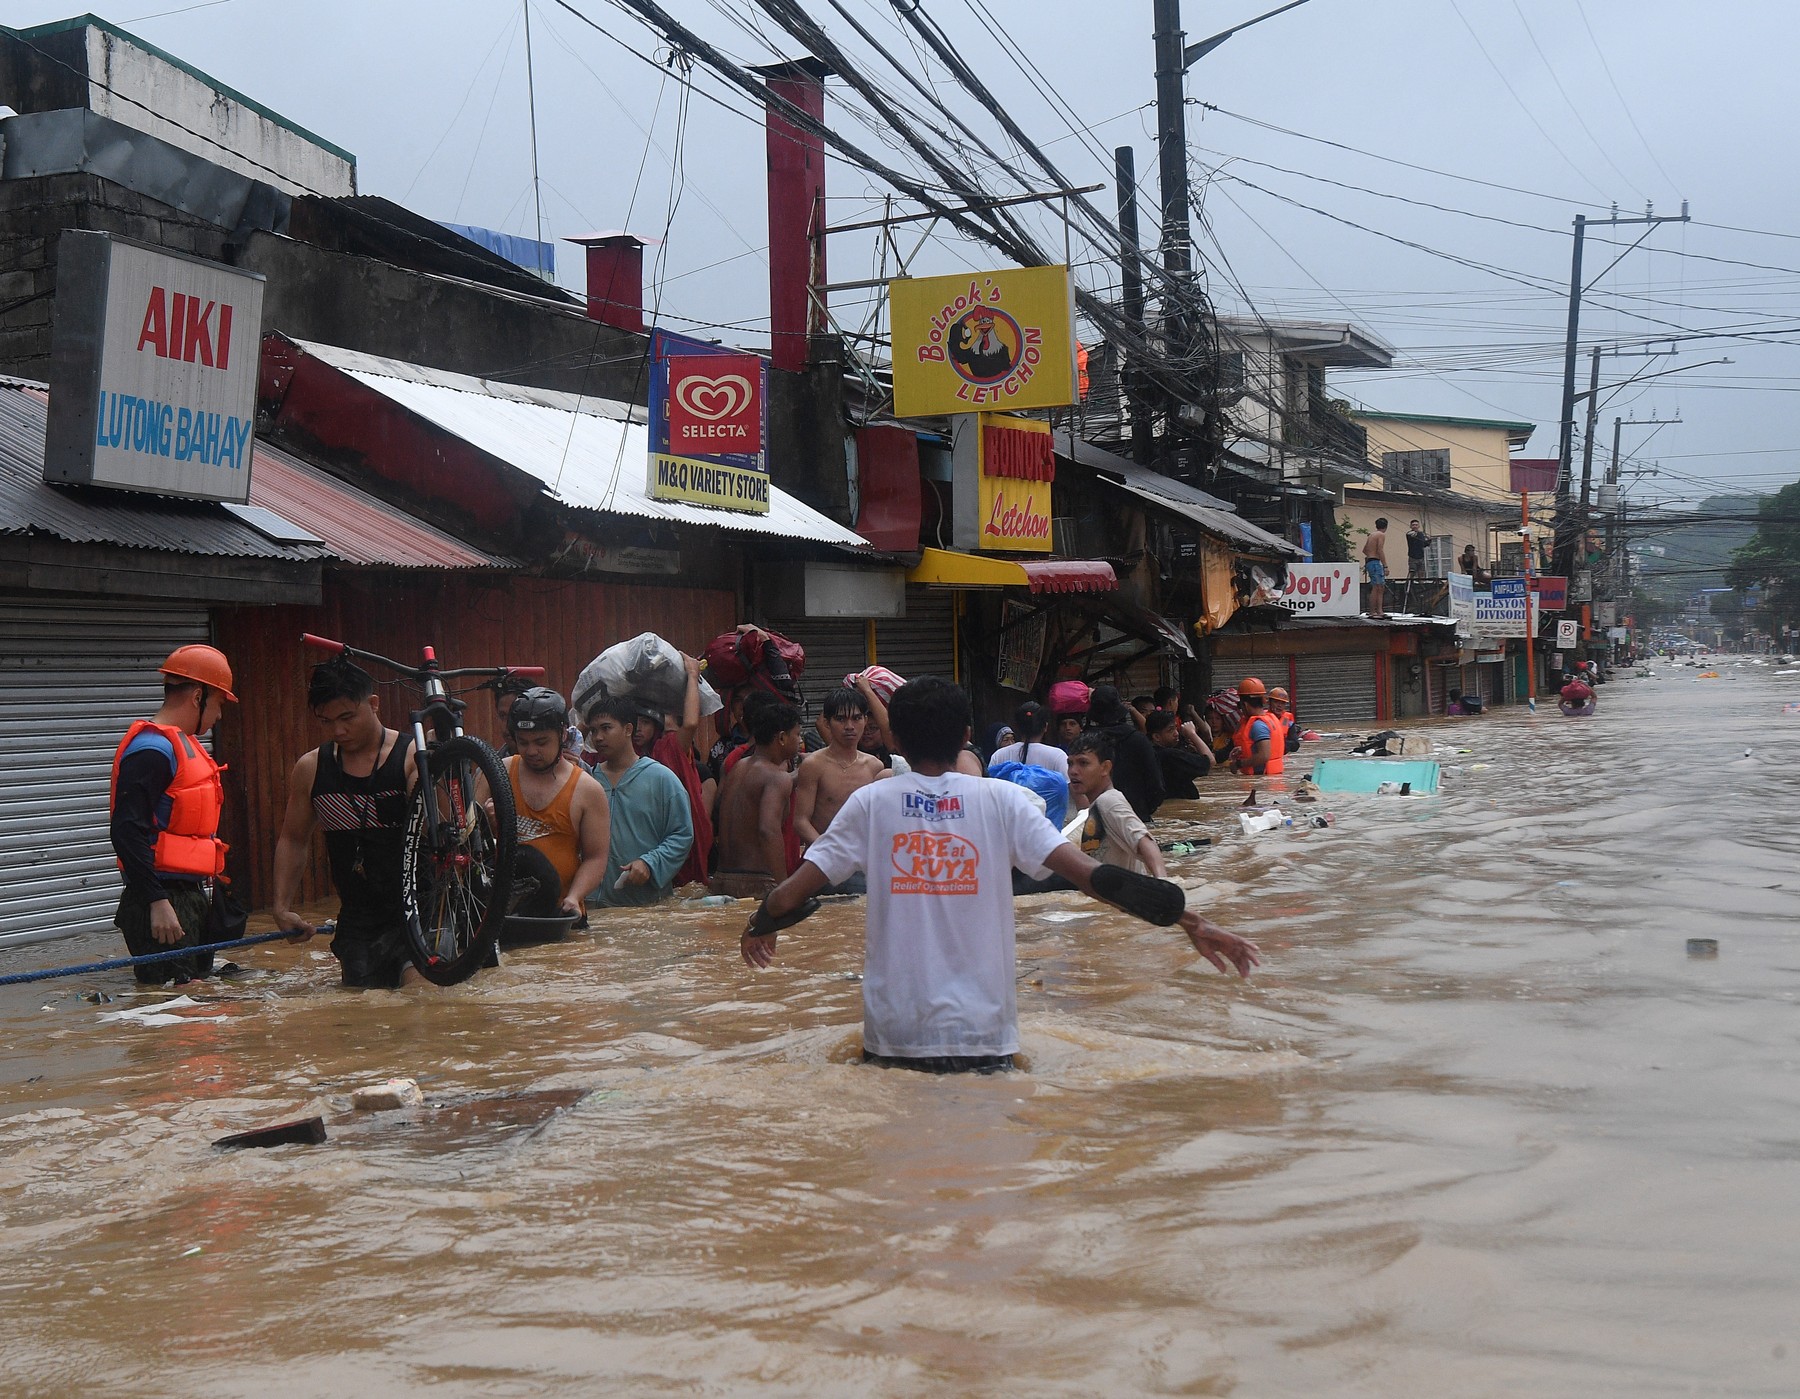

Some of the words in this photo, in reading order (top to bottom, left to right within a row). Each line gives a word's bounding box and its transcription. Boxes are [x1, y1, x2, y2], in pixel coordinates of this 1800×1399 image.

[137, 286, 232, 370] AIKI
[918, 279, 1001, 363] Boinok's
[956, 327, 1042, 403] LETCHON
[97, 390, 173, 457] LUTONG
[175, 407, 251, 469] BAHAY
[682, 424, 747, 438] SELECTA
[658, 459, 687, 492] M&Q
[690, 465, 735, 497] VARIETY
[736, 473, 767, 502] STORE
[984, 492, 1049, 538] Letchon
[1476, 609, 1532, 619] DIVISORI
[892, 833, 952, 857] PARE
[952, 845, 966, 857] at
[893, 881, 922, 891] Relief
[924, 882, 976, 892] Operations
[912, 856, 976, 879] KUYA
